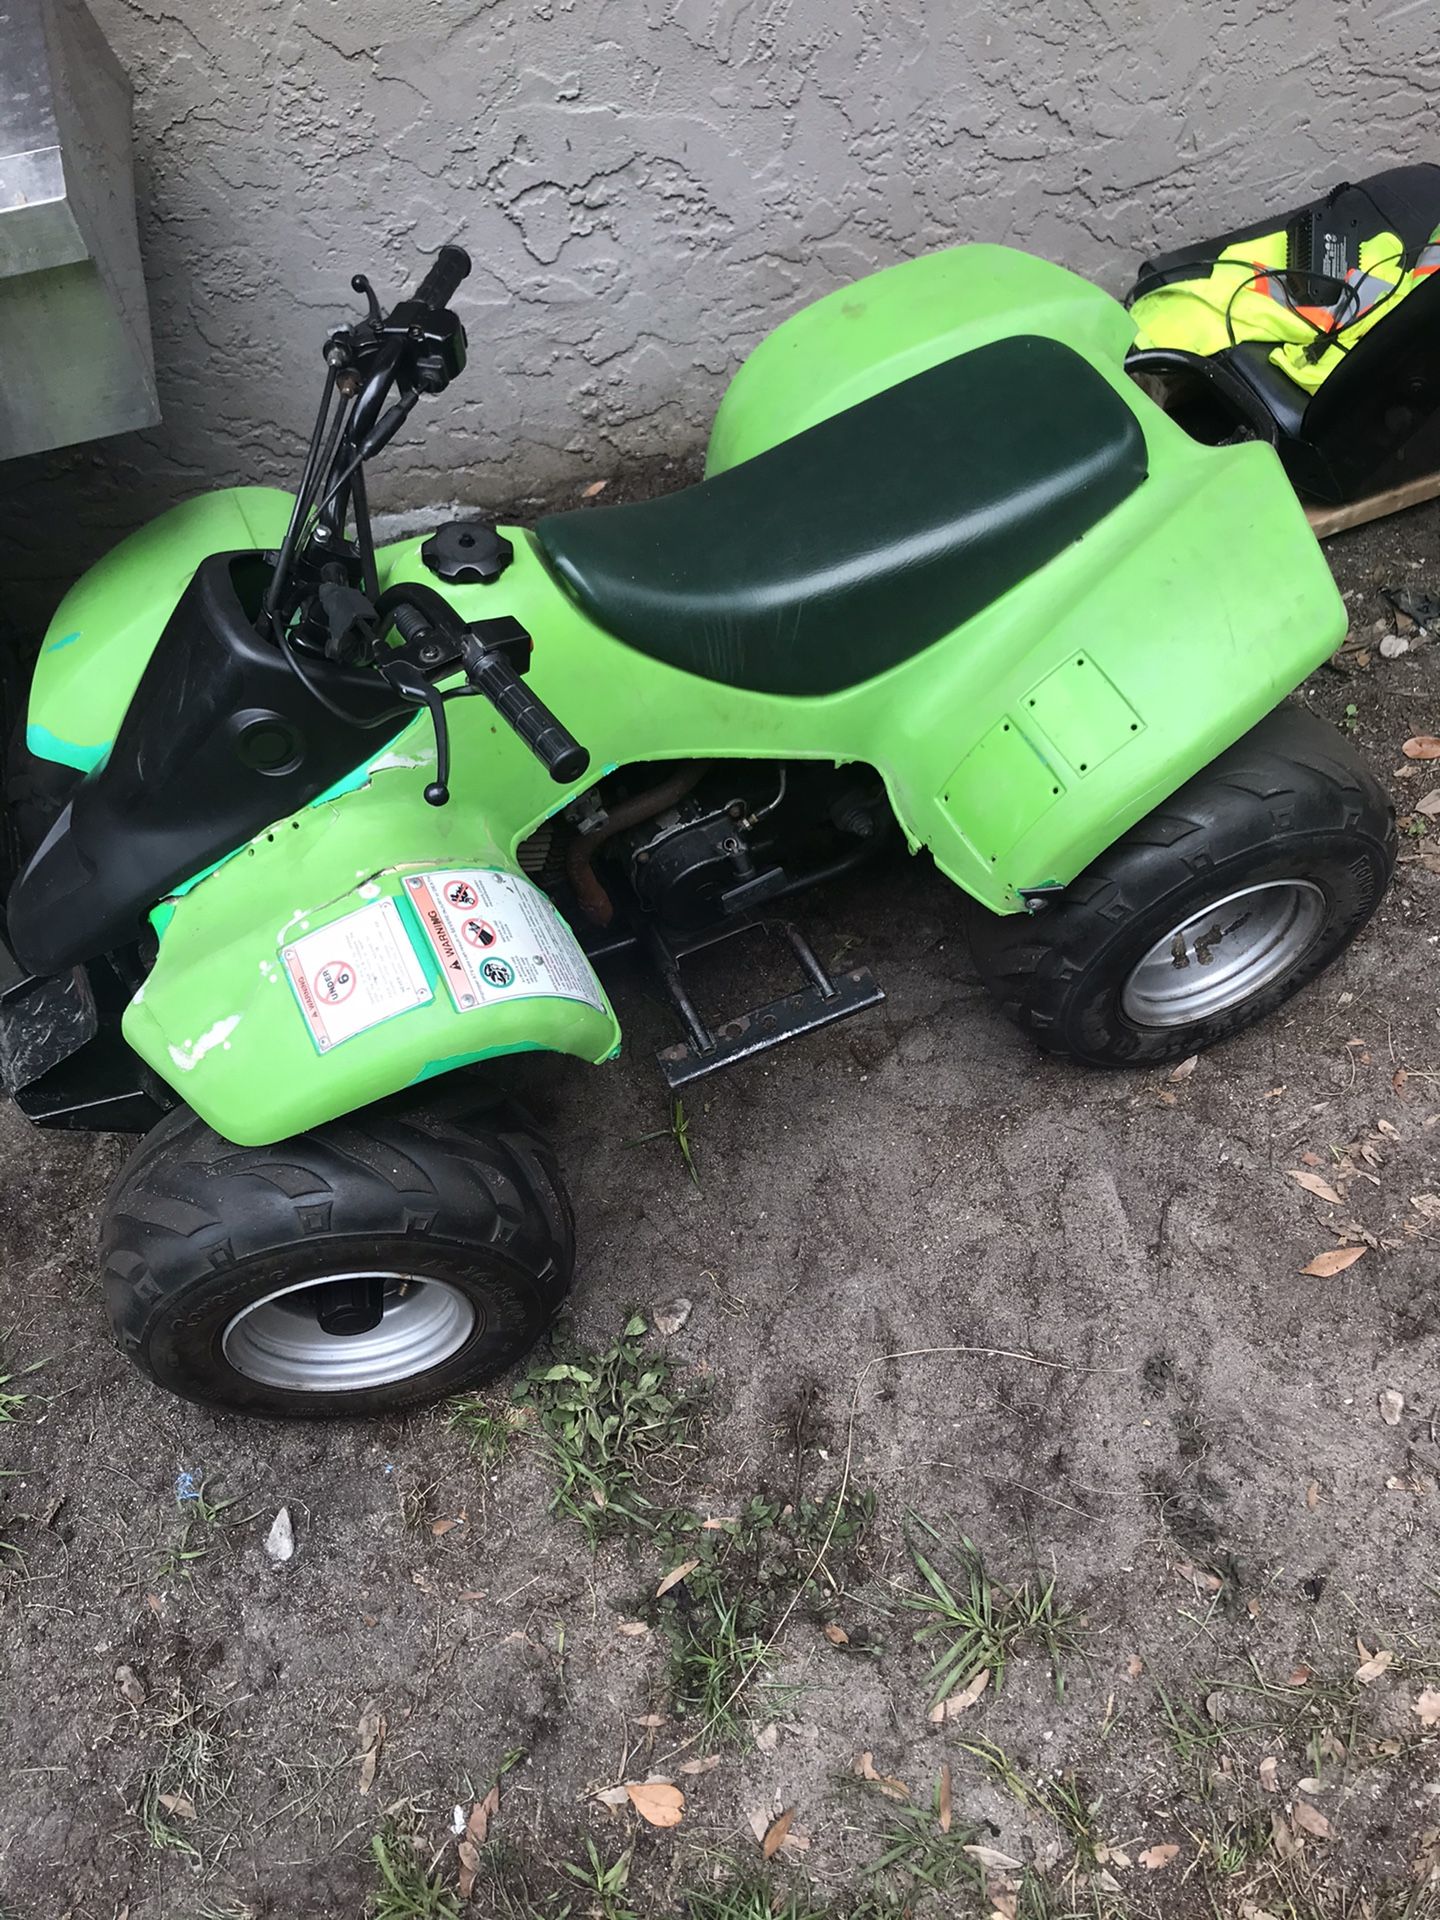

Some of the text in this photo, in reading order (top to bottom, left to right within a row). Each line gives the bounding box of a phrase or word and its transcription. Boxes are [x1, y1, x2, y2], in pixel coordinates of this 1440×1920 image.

[425, 908, 455, 958] WARNING
[296, 975, 315, 1011] WARNING
[320, 969, 339, 1001] UNDER
[336, 973, 349, 985] 6
